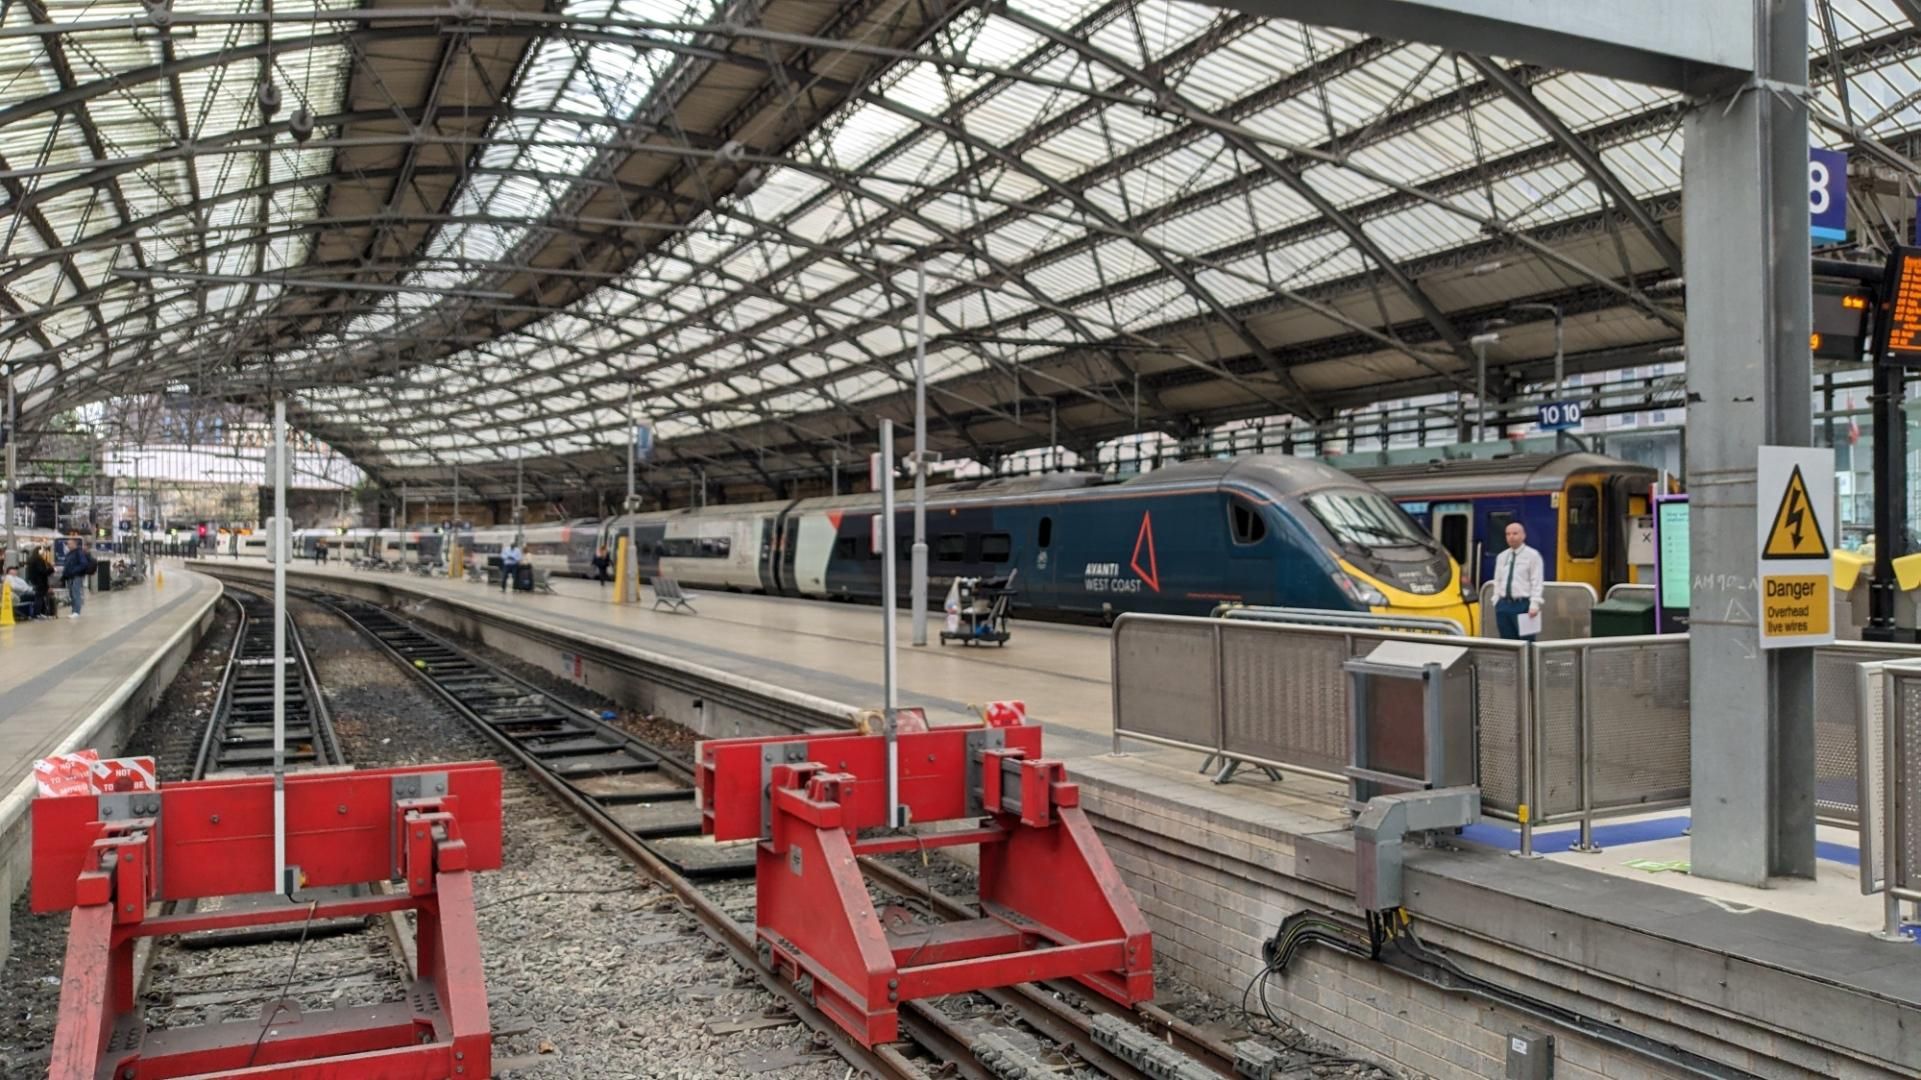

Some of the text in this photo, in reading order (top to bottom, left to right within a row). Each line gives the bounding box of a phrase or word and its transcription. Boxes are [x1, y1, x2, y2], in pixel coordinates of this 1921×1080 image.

[1808, 161, 1830, 214] 8
[1541, 403, 1580, 424] 10 10
[1085, 563, 1119, 576] AVANTI
[1085, 579, 1141, 593] WEST COAST
[1767, 580, 1815, 599] Danger
[1768, 606, 1809, 618] Overhead
[1768, 620, 1808, 633] live wires
[115, 769, 131, 777] NOT
[104, 780, 144, 792] TO BE
